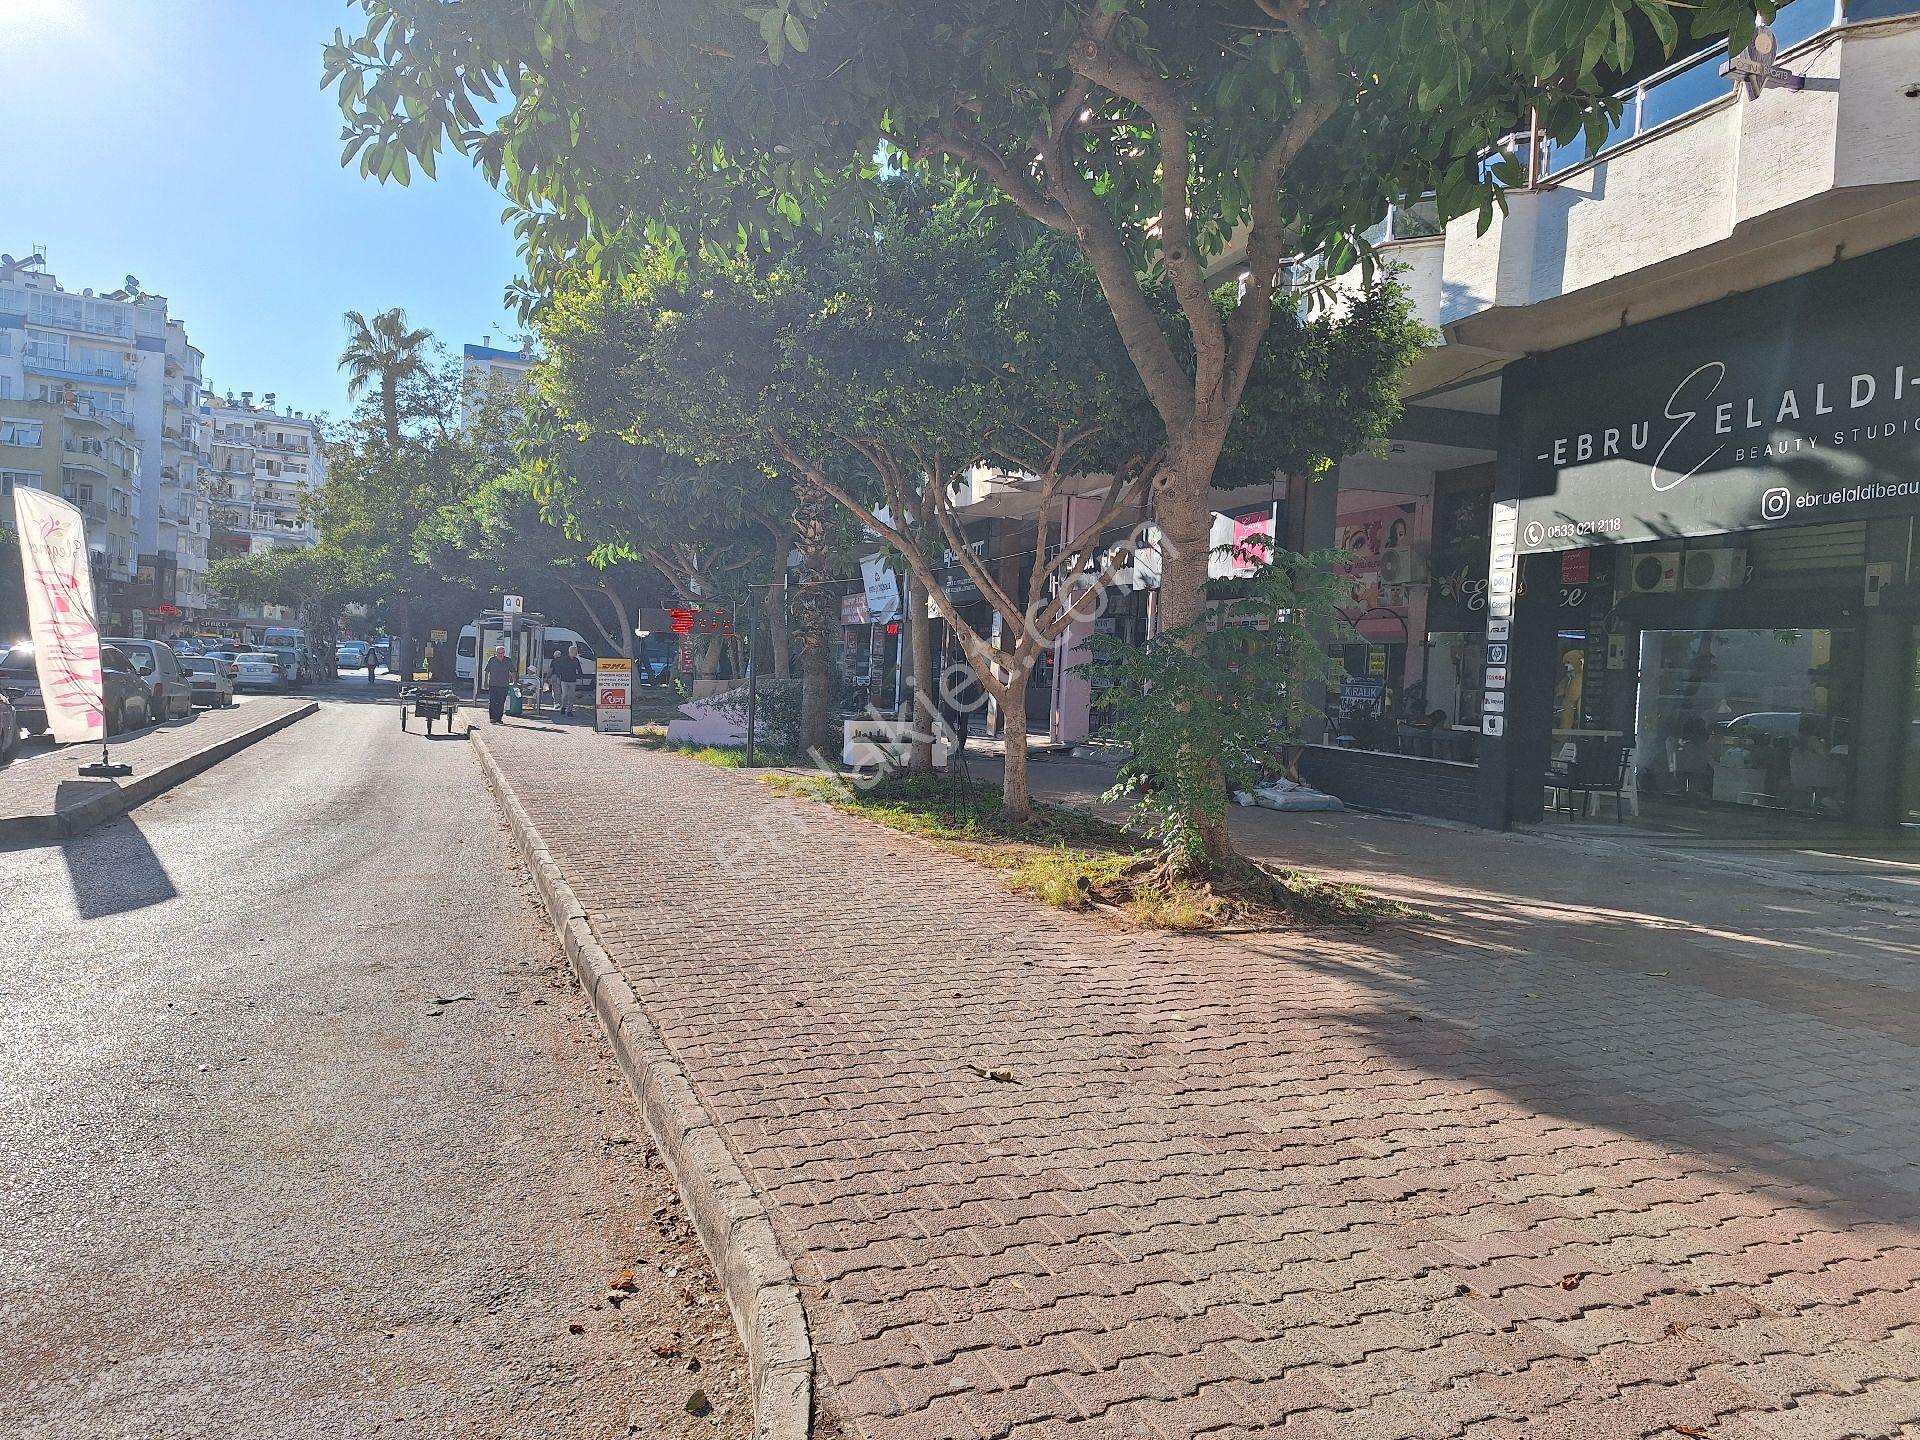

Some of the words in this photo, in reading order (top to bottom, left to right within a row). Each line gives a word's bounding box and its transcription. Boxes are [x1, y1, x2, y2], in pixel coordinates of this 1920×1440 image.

[1735, 436, 1818, 462] BEAUTY
[1548, 525, 1574, 538] 0533
[1576, 522, 1595, 535] 021
[1597, 518, 1621, 534] 2118
[1493, 577, 1509, 587] DELL
[1491, 601, 1510, 610] Casper
